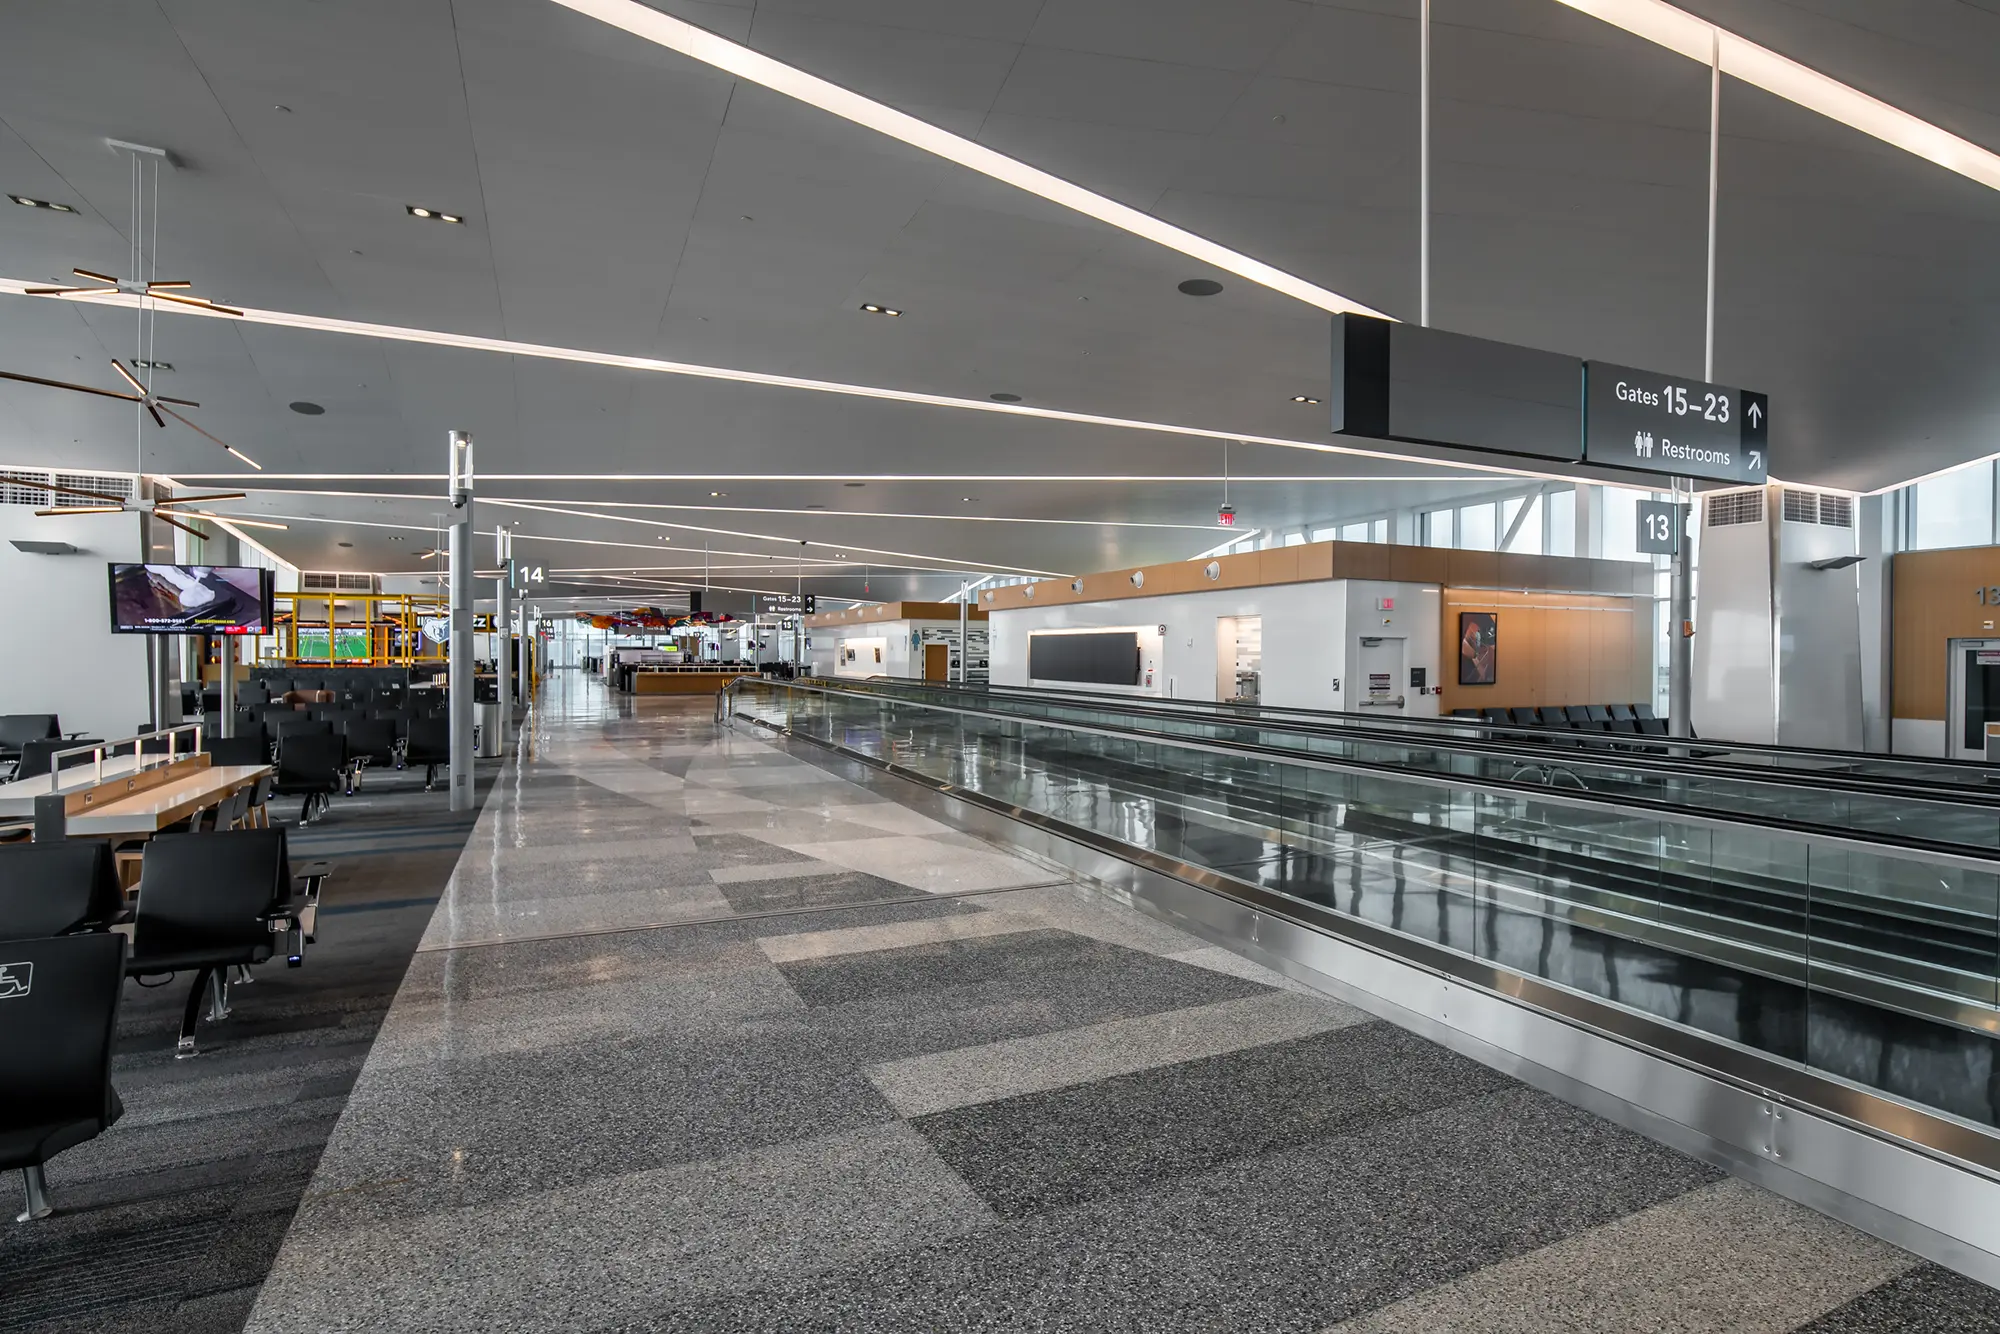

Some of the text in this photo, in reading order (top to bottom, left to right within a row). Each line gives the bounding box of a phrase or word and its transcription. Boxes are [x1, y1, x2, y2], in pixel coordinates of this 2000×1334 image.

[1615, 381, 1659, 406] Gates
[1661, 438, 1731, 466] Restrooms
[1645, 513, 1670, 541] 13
[519, 566, 544, 583] 14
[542, 619, 552, 627] 16
